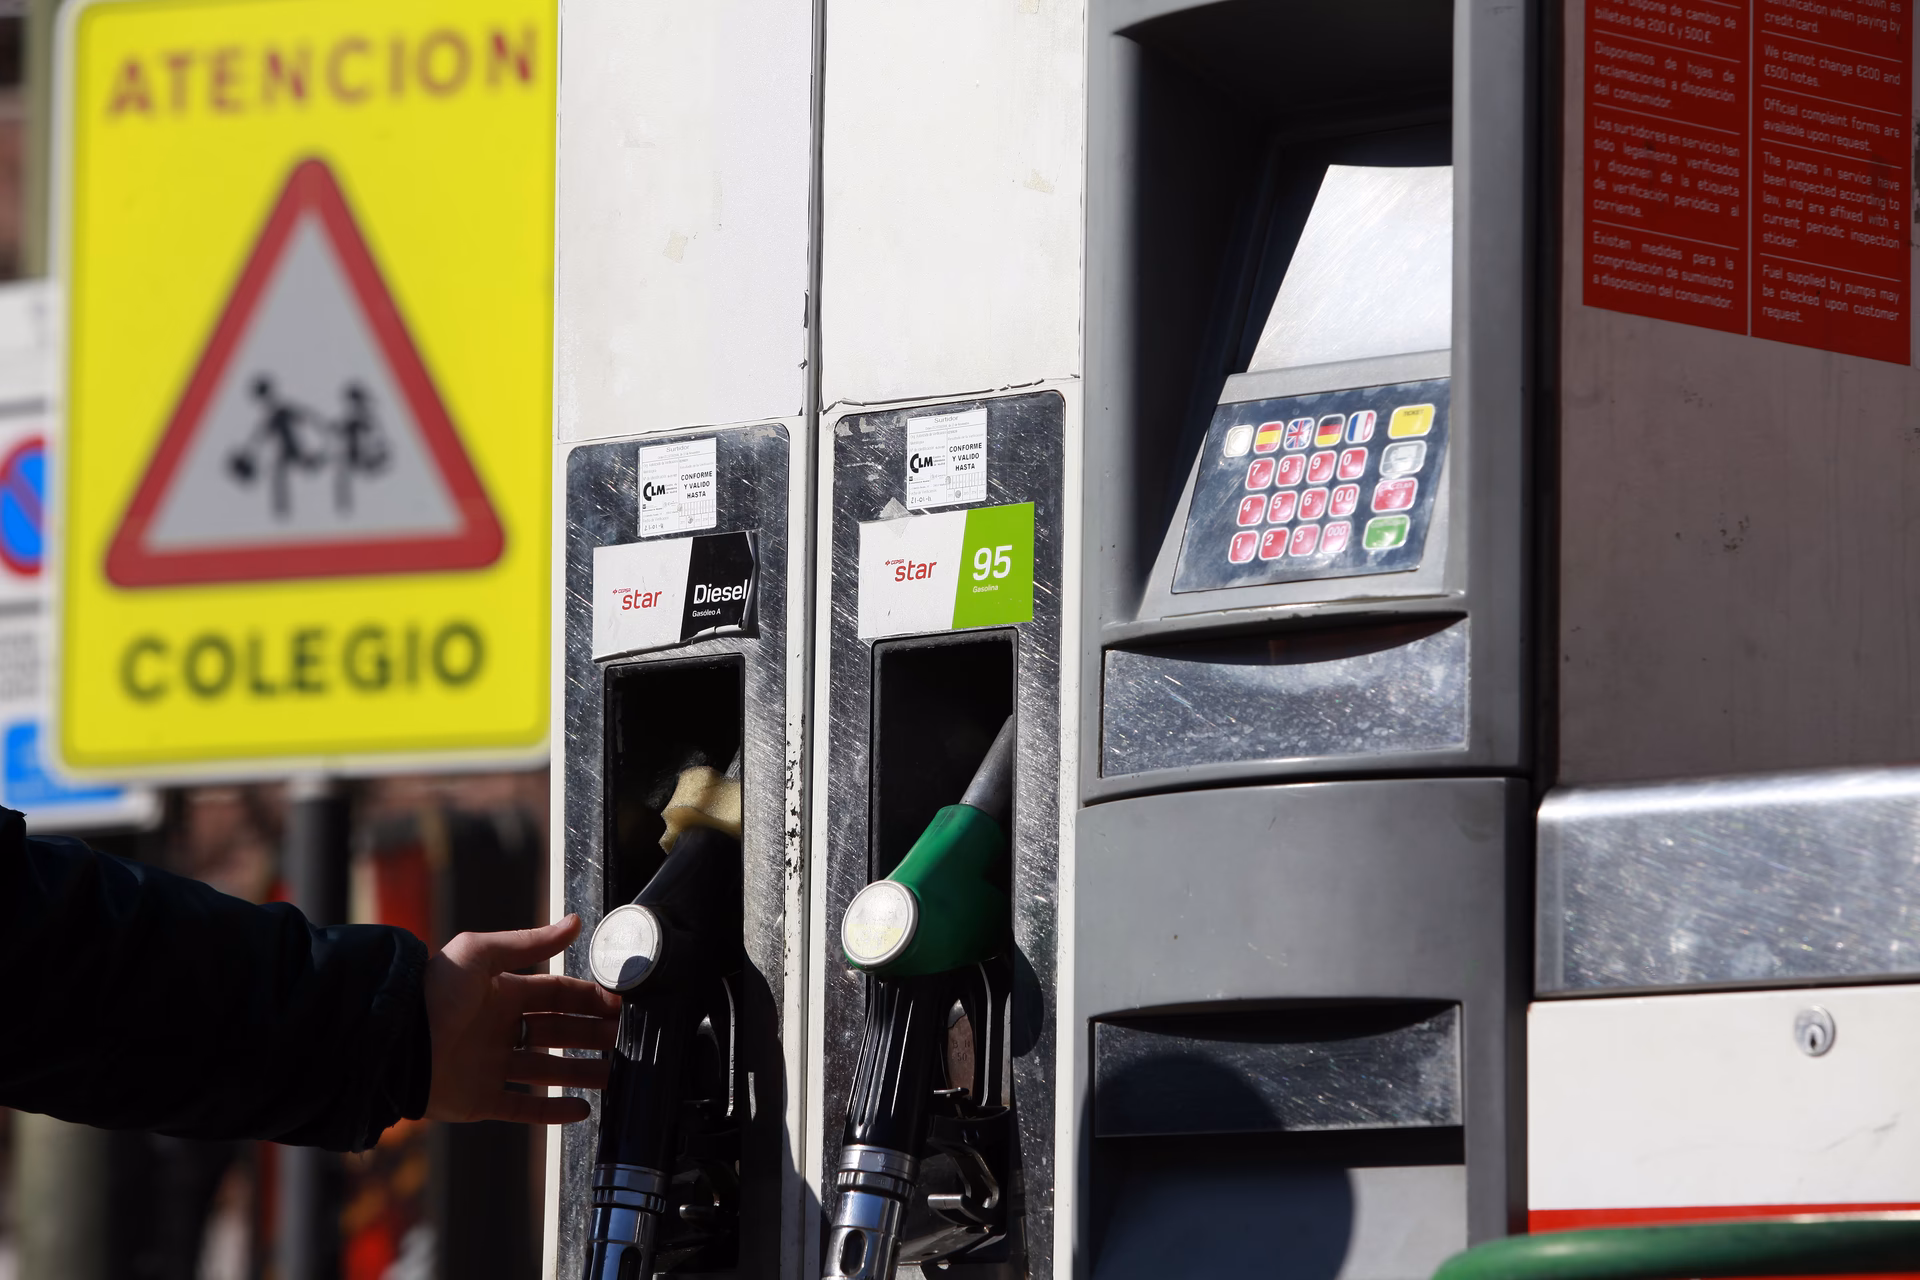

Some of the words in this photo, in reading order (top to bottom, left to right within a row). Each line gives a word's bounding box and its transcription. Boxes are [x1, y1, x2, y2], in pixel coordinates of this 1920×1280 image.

[1890, 2, 1901, 12] as
[1686, 9, 1721, 26] cambio
[1764, 13, 1794, 27] credit
[1765, 0, 1828, 16] ntification
[1830, 6, 1854, 22] when
[1857, 14, 1887, 32] paying
[1890, 18, 1901, 35] by
[1633, 15, 1645, 29] de
[1647, 18, 1666, 33] 200
[1685, 26, 1703, 41] 500
[1594, 41, 1655, 66] Disponemos
[1665, 57, 1677, 70] de
[1687, 60, 1713, 79] hojas
[1723, 69, 1735, 83] de
[1764, 44, 1779, 58] We
[1782, 50, 1816, 66] cannot
[1819, 57, 1853, 76] change
[1857, 65, 1880, 81] €200
[1883, 73, 1900, 85] and
[108, 26, 540, 120] ATENCION
[1594, 64, 1666, 88] reclamaciones
[1671, 80, 1677, 90] a
[1764, 64, 1788, 80] €500
[1594, 81, 1609, 96] del
[1764, 98, 1798, 116] Official
[1801, 108, 1848, 127] complaint
[1852, 116, 1880, 134] forms
[1884, 127, 1900, 138] are
[1594, 116, 1612, 131] Los
[1682, 137, 1720, 154] servicio
[1722, 143, 1740, 157] han
[1764, 120, 1804, 137] available
[1807, 129, 1830, 143] upon
[1832, 135, 1872, 151] request.
[1594, 137, 1615, 152] sido
[1660, 170, 1673, 184] de
[1680, 173, 1689, 187] la
[1763, 151, 1781, 166] The
[1786, 159, 1818, 175] pumps
[1824, 164, 1832, 176] in
[1838, 170, 1872, 185] service
[1877, 176, 1900, 191] have
[1593, 177, 1606, 190] de
[1763, 170, 1786, 187] been
[1790, 177, 1836, 197] inspected
[1840, 190, 1886, 210] according
[1889, 197, 1900, 210] to
[1786, 198, 1803, 210] and
[1808, 203, 1824, 214] are
[1830, 205, 1863, 222] affixed
[1868, 214, 1889, 227] with
[1894, 220, 1900, 230] a
[1763, 213, 1801, 229] current
[1807, 222, 1845, 238] periodic
[1850, 229, 1900, 249] inspection
[1593, 231, 1632, 249] Existen
[1641, 243, 1682, 260] medidas
[1692, 253, 1716, 266] para
[1725, 256, 1734, 270] la
[1593, 274, 1599, 284] a
[1658, 284, 1673, 297] del
[1666, 266, 1678, 279] de
[1681, 270, 1734, 290] suministro
[1763, 264, 1783, 279] Fuel
[1787, 272, 1826, 288] supplied
[1830, 277, 1841, 293] by
[1845, 284, 1876, 299] pumps
[1880, 290, 1900, 305] may
[1762, 284, 1775, 298] be
[1780, 288, 1820, 306] checked
[1825, 299, 1848, 311] upon
[1853, 305, 1899, 321] customer
[949, 443, 982, 452] CONFORME
[910, 453, 933, 473] CLM
[958, 453, 979, 461] VALIDO
[1312, 457, 1321, 469] 9
[1343, 454, 1352, 466] 0
[955, 463, 975, 471] HASTA
[1252, 464, 1260, 476] 7
[1282, 461, 1290, 472] 8
[681, 471, 712, 481] CONFORME
[643, 482, 665, 501] CLM
[689, 481, 710, 489] VALIDO
[687, 491, 706, 499] HASTA
[1274, 497, 1282, 509] 5
[1304, 494, 1312, 506] 6
[1243, 500, 1251, 512] 4
[1296, 531, 1304, 542] 3
[1328, 526, 1346, 536] 000
[1236, 538, 1242, 548] 1
[1265, 534, 1274, 546] 2
[894, 560, 937, 582] star
[972, 544, 1012, 581] 95
[694, 579, 748, 604] Diesel
[972, 584, 998, 593] Gasolina
[622, 589, 662, 611] star
[120, 620, 490, 704] COLEGIO
[958, 1053, 967, 1061] 50
